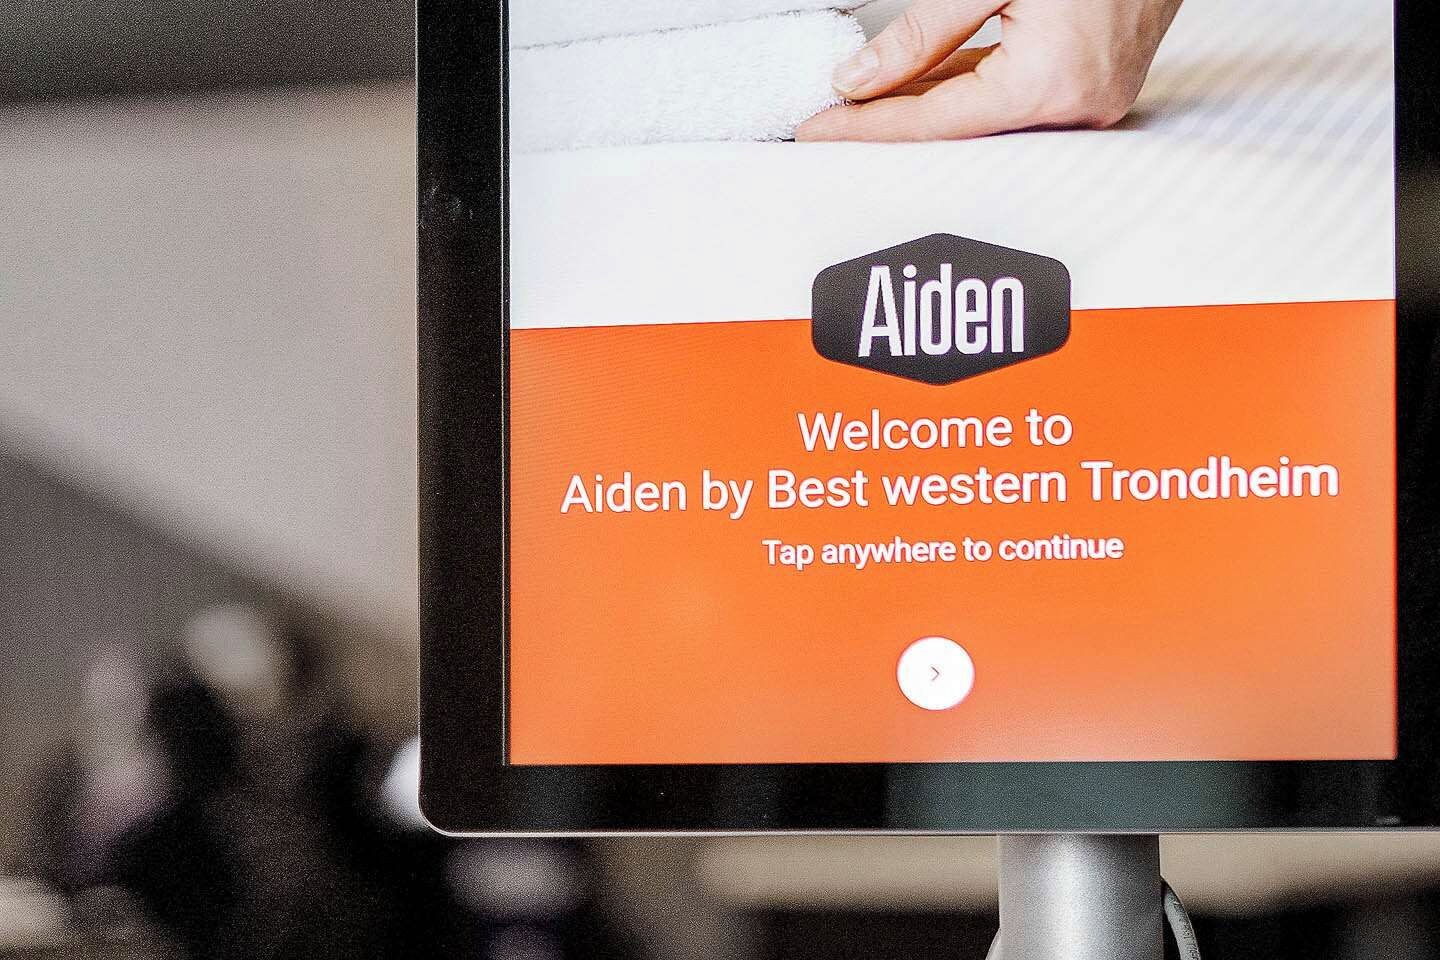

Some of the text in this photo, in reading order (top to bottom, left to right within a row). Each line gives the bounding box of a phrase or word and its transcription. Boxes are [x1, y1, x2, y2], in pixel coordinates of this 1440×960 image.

[858, 264, 1025, 358] Aiden
[797, 408, 1073, 452] Welcome to
[559, 455, 1339, 521] Aiden by Best western Trondheim
[762, 534, 1124, 571] Tap anywhere to continue
